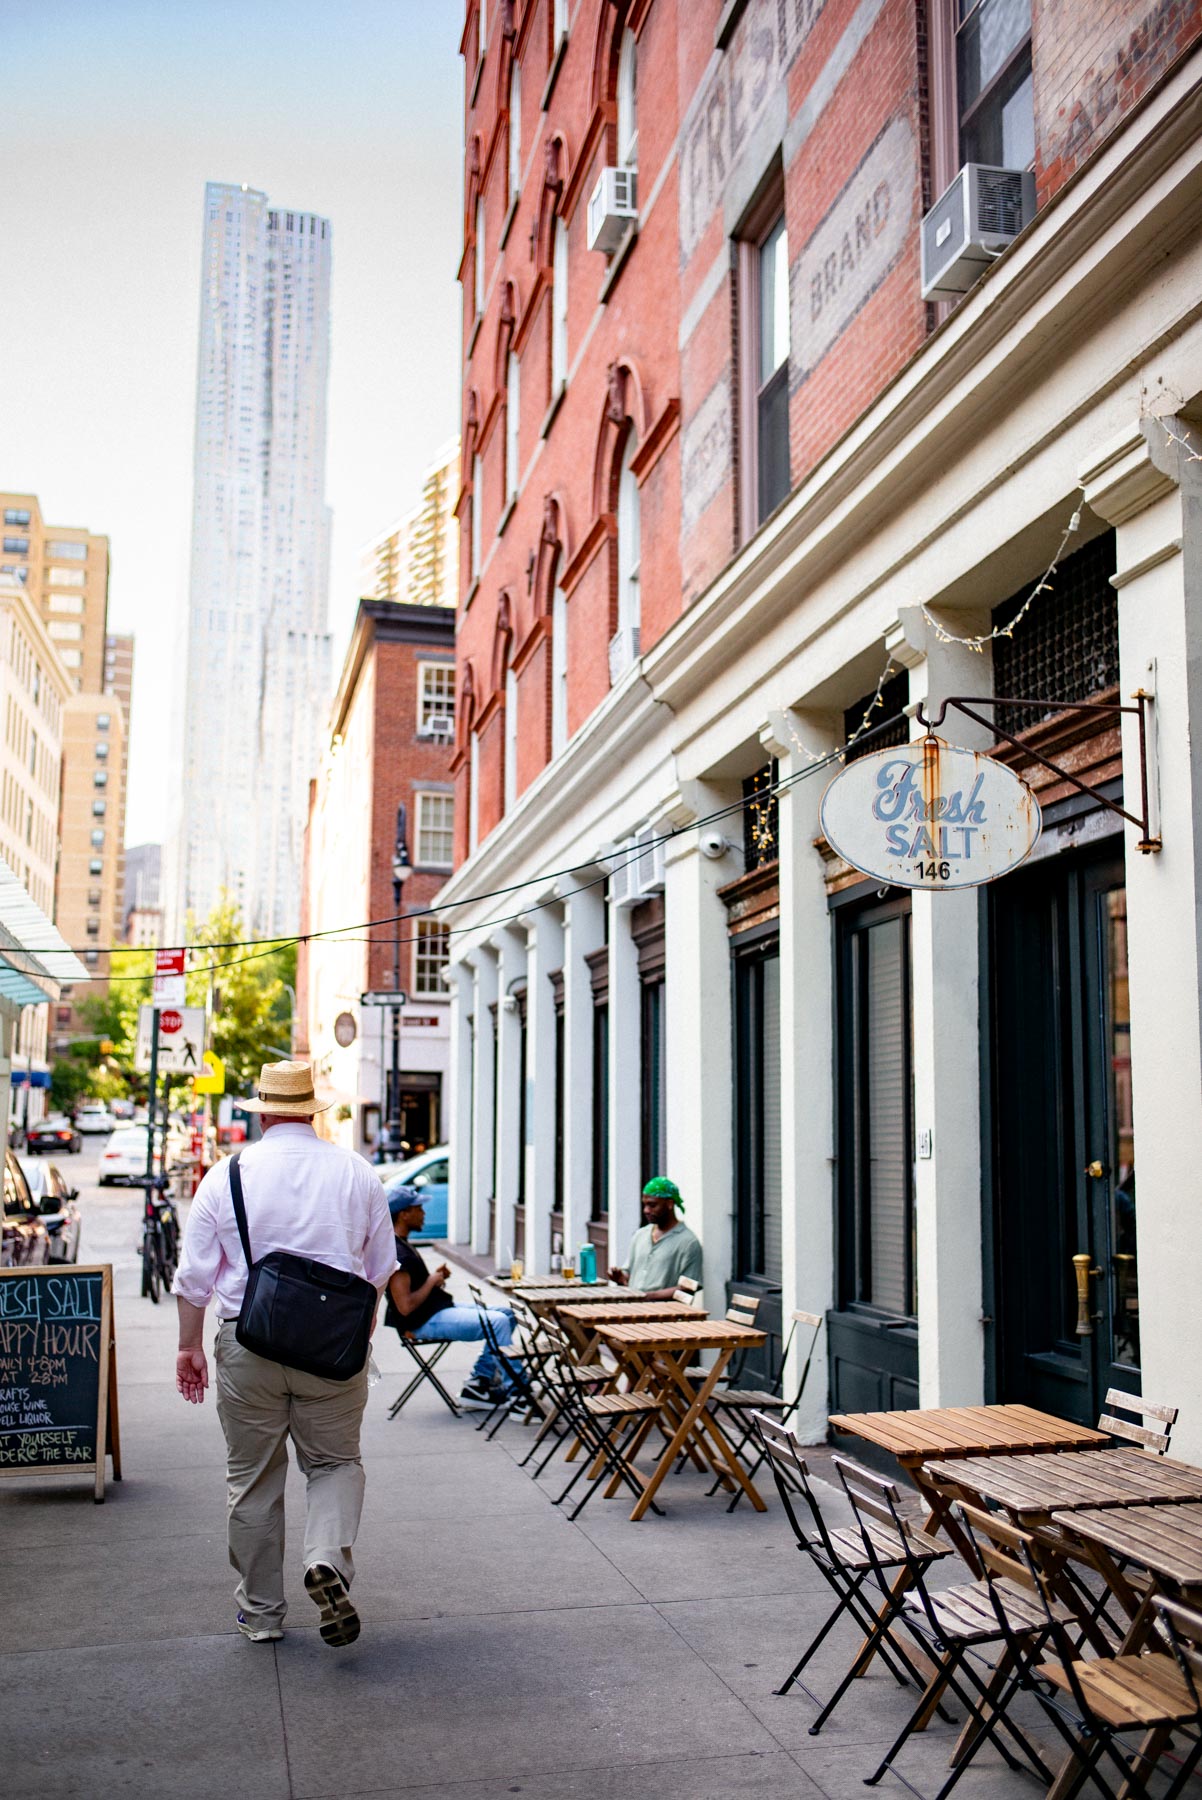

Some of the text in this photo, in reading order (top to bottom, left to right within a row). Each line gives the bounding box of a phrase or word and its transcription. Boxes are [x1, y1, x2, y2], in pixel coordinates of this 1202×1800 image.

[810, 180, 891, 323] BRAND
[872, 757, 987, 824] Fresh
[885, 824, 979, 860] SALT
[915, 861, 951, 880] 146
[160, 1018, 182, 1029] STOP
[47, 1278, 102, 1318] SALT
[43, 1323, 98, 1362] HOUR
[0, 1356, 22, 1371] AILY
[23, 1400, 48, 1411] WINE
[0, 1411, 54, 1427] ELL LIQUOR
[17, 1430, 78, 1447] YOURSELF
[38, 1447, 61, 1461] THE
[64, 1446, 92, 1461] BAR
